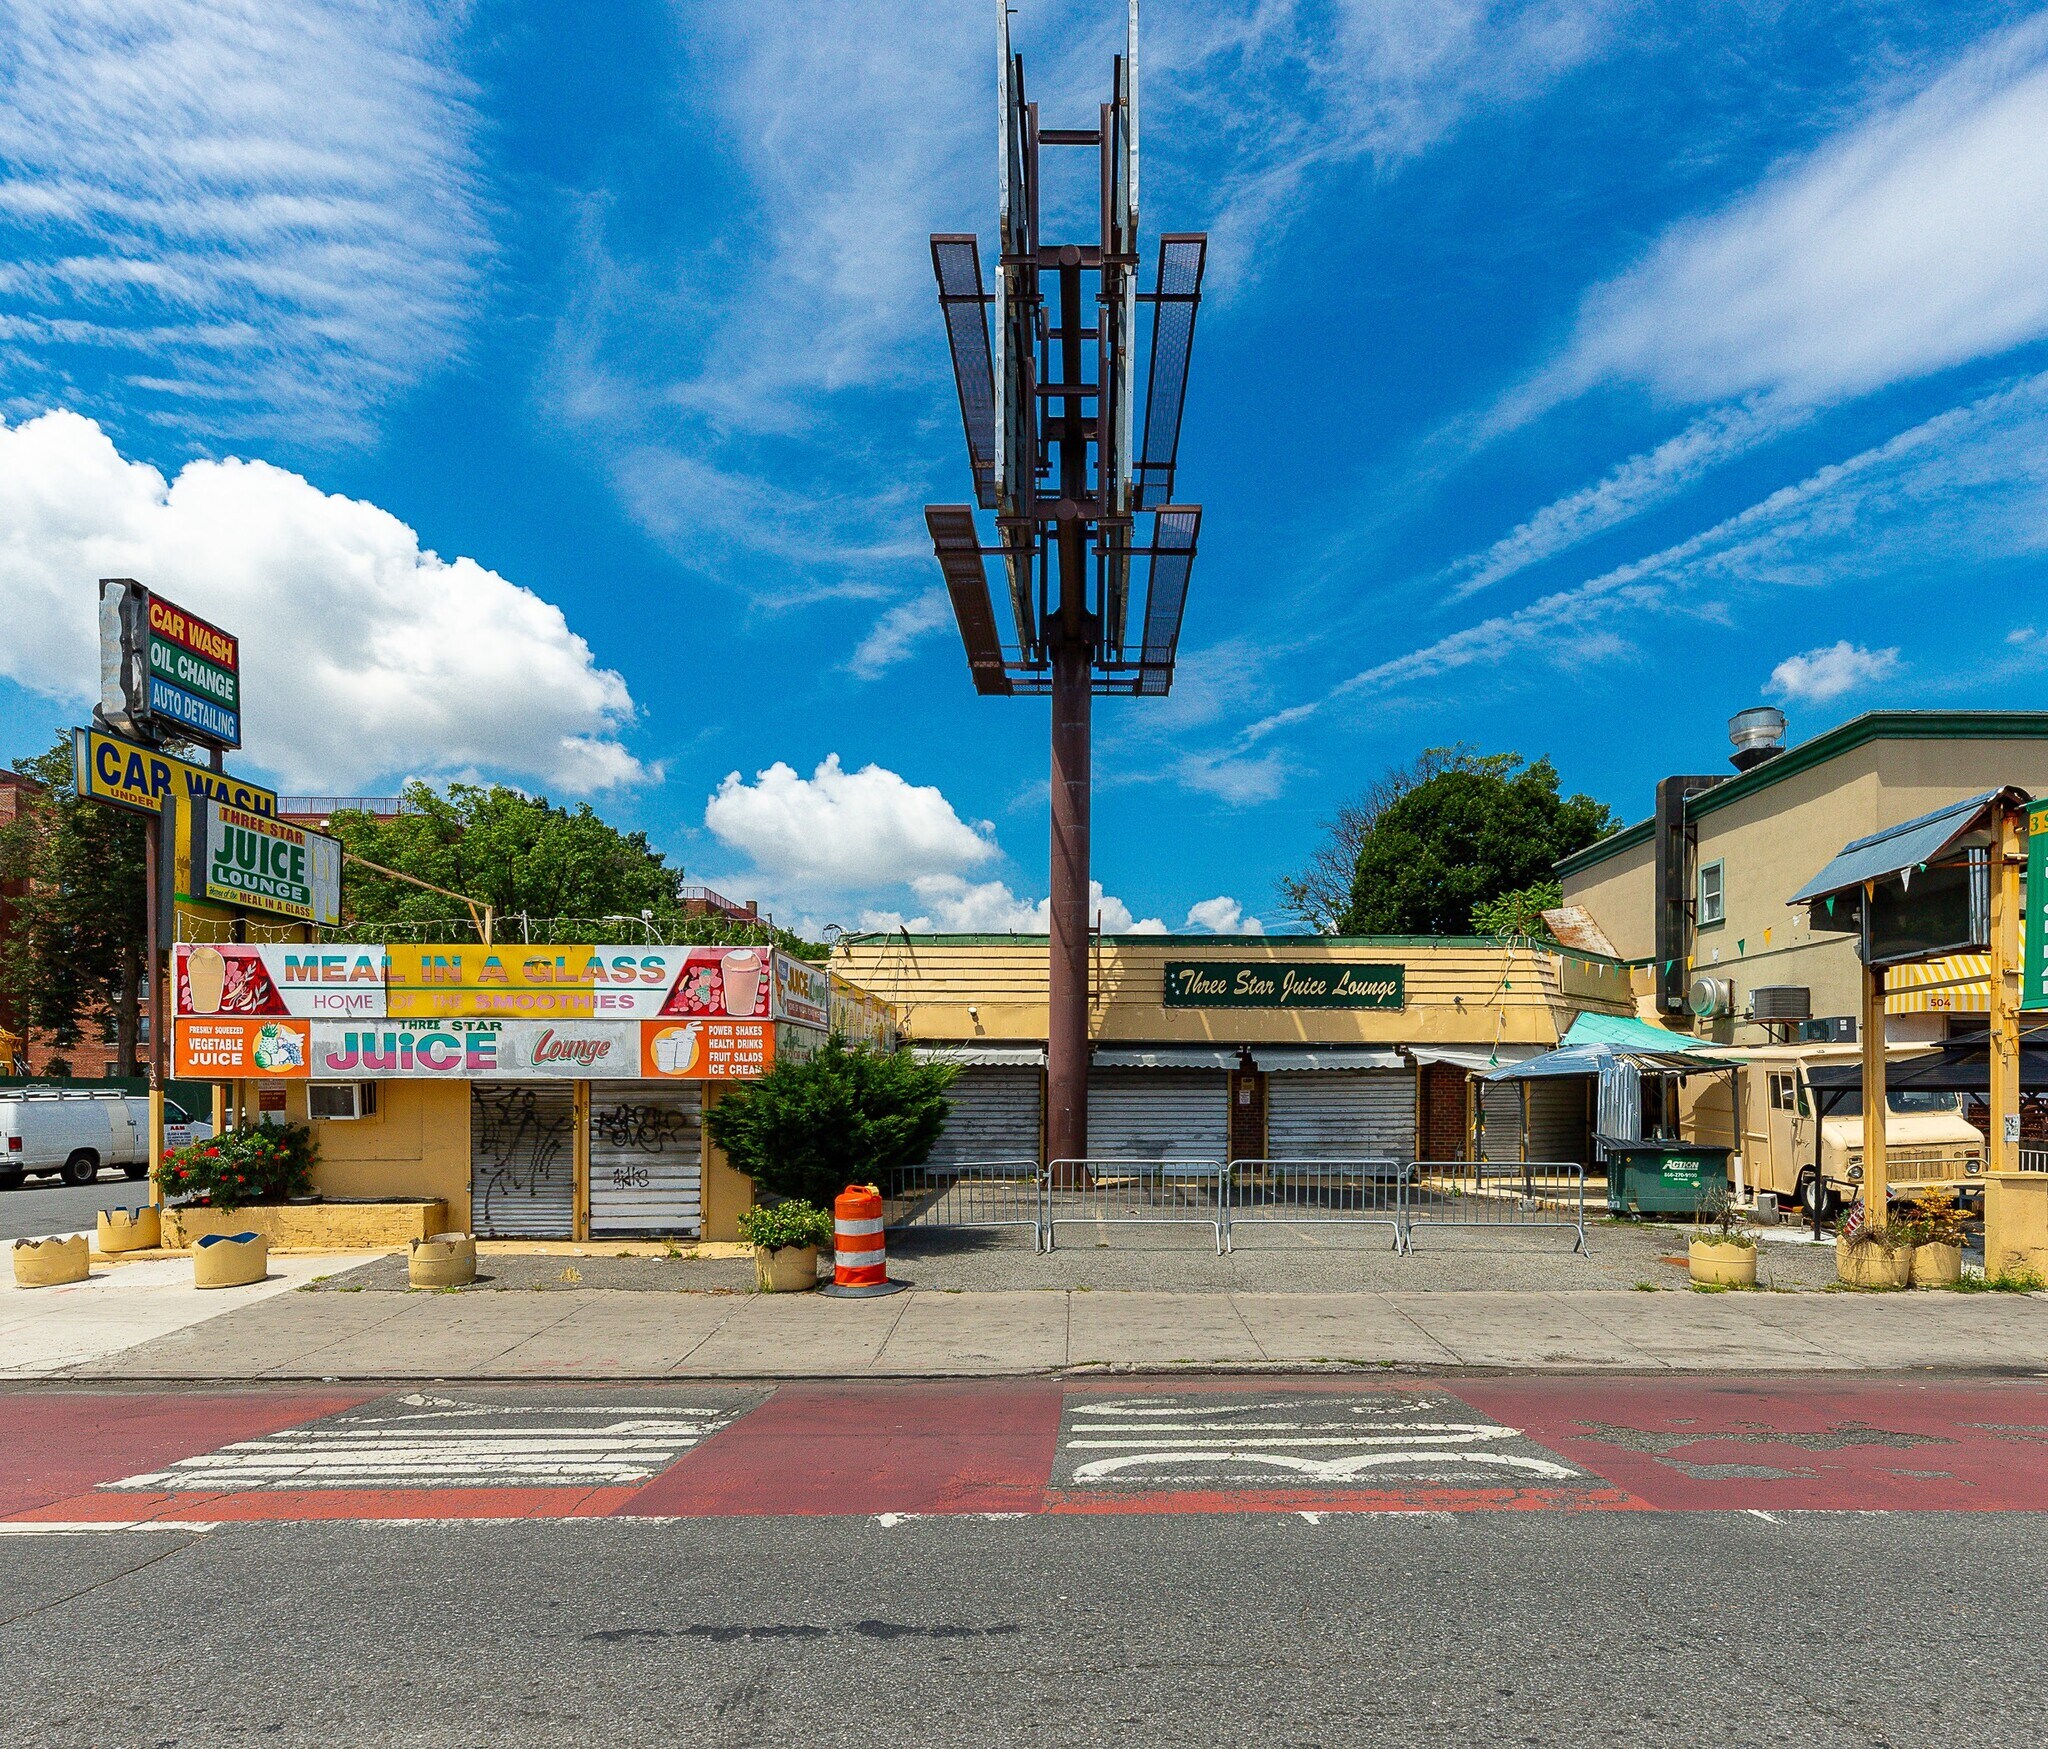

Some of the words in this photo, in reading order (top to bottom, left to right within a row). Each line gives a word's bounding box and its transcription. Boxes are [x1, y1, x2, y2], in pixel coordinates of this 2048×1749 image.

[150, 603, 185, 641] CAR
[188, 621, 233, 665] WASH
[150, 641, 174, 674] OIL
[177, 655, 234, 701] CHANGE
[153, 682, 182, 716] AUTO
[184, 695, 235, 739] DETAILING
[96, 742, 173, 799] CAR
[110, 787, 154, 808] UNDER
[221, 806, 264, 835] THREE
[270, 823, 304, 844] STAR
[2030, 816, 2039, 832] 3
[215, 824, 305, 885] JUICE
[218, 867, 303, 901] LOUNGE
[208, 885, 223, 896] Home
[239, 892, 262, 906] MEAL
[265, 898, 273, 909] IN
[276, 902, 283, 911] A
[285, 904, 310, 917] GLASS
[284, 955, 406, 982] MEAL
[421, 955, 462, 982] IN
[477, 956, 510, 983] A
[522, 955, 666, 983] GLASS
[1178, 969, 1228, 995] Three
[1233, 969, 1275, 995] Star
[1281, 969, 1331, 1003] Juice
[1331, 970, 1397, 1004] Lounge
[314, 994, 374, 1009] HOME
[389, 995, 416, 1010] OF
[432, 994, 463, 1010] THE
[475, 994, 635, 1010] SMOOTHIES
[1930, 998, 1951, 1007] 504
[189, 1025, 213, 1034] FRESHLY
[215, 1026, 244, 1035] SQUEEZED
[400, 1019, 441, 1031] THREE
[451, 1020, 503, 1032] STAR
[708, 1025, 733, 1036] POWER
[735, 1025, 763, 1036] SHAKES
[188, 1037, 244, 1051] VEGETABLE
[530, 1028, 612, 1066] Lounge
[708, 1038, 734, 1049] HEALTH
[737, 1038, 764, 1049] DRINKS
[188, 1052, 243, 1066] JUICE
[709, 1051, 731, 1062] FRUIT
[733, 1051, 764, 1062] SALADS
[708, 1064, 725, 1075] ICE
[1662, 1159, 1699, 1170] ACTION
[1066, 1397, 1581, 1485] BUS
